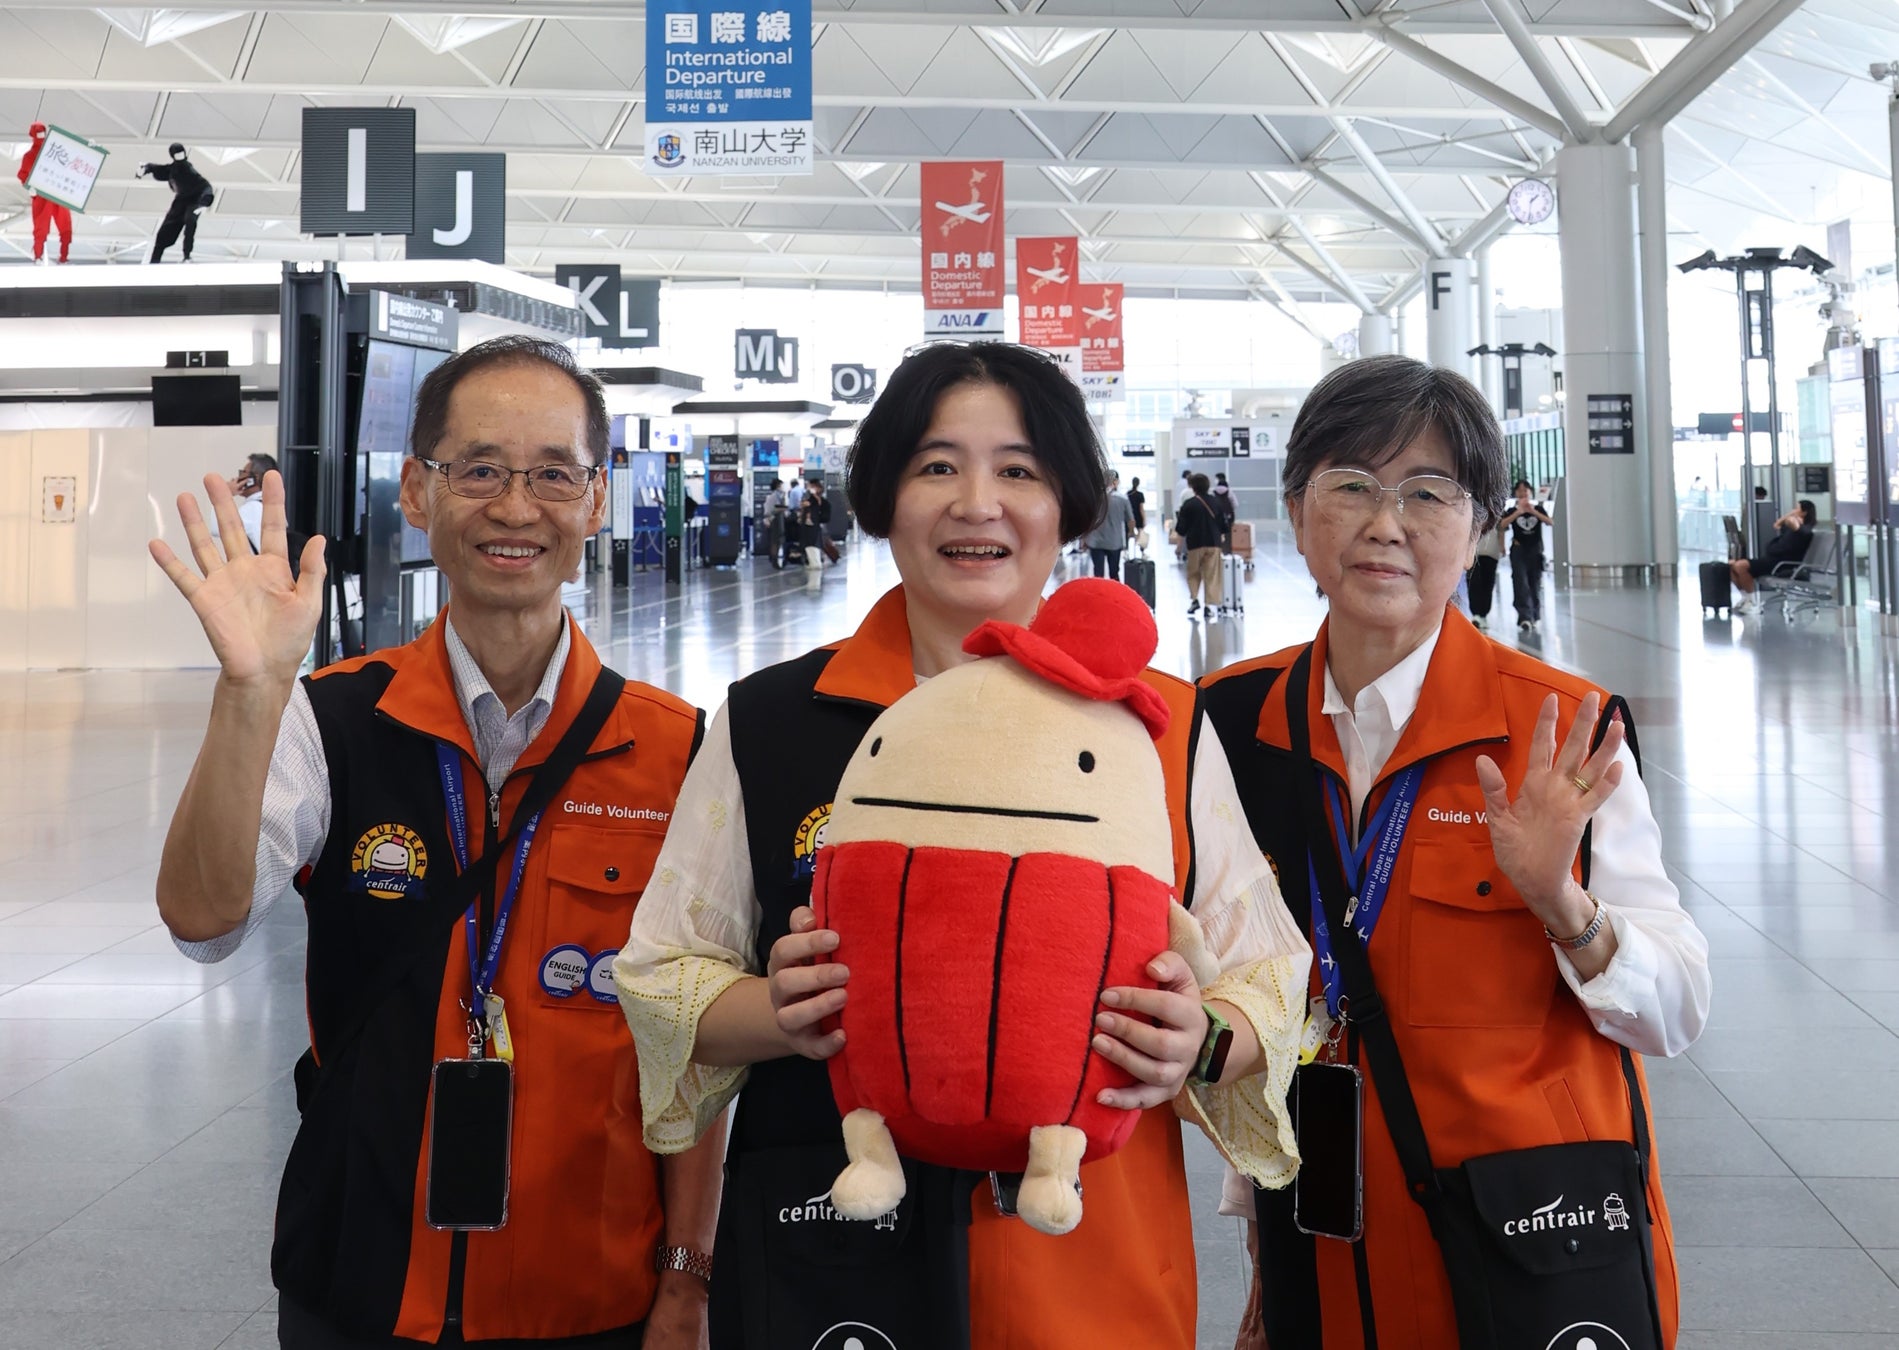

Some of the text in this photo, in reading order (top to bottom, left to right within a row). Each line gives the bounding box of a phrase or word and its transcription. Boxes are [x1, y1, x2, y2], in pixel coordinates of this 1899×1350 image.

[665, 11, 792, 44] 国際線
[666, 48, 793, 66] International
[666, 68, 766, 87] Departure
[665, 102, 729, 114] 국제선 출발
[694, 128, 806, 154] 南山大学
[347, 128, 366, 211] I
[692, 157, 739, 167] NANZAN
[741, 156, 806, 166] UNIVERSITY
[433, 171, 473, 246] J
[931, 251, 995, 269] 国内線
[931, 271, 981, 280] Domestic
[931, 281, 982, 290] Departure
[568, 276, 609, 326] K
[1432, 272, 1451, 310] F
[620, 291, 648, 338] L
[938, 314, 971, 327] ANA
[185, 351, 206, 367] I-1
[738, 335, 774, 371] M
[834, 367, 862, 397] O
[1082, 377, 1103, 385] SKY
[444, 763, 455, 793] Airport
[449, 795, 464, 847] International
[564, 800, 670, 821] Guide Volunteer
[1427, 808, 1472, 824] Guide
[352, 823, 426, 868] VOLUNTEER
[1380, 801, 1411, 884] GUIDE VOLUNTEER
[1361, 881, 1377, 912] Central
[1372, 854, 1385, 880] Japan
[1380, 799, 1402, 853] International
[366, 878, 408, 892] centrair
[548, 960, 587, 975] ENGLISH
[554, 971, 577, 981] GUIDE
[1504, 1199, 1596, 1236] centrair
